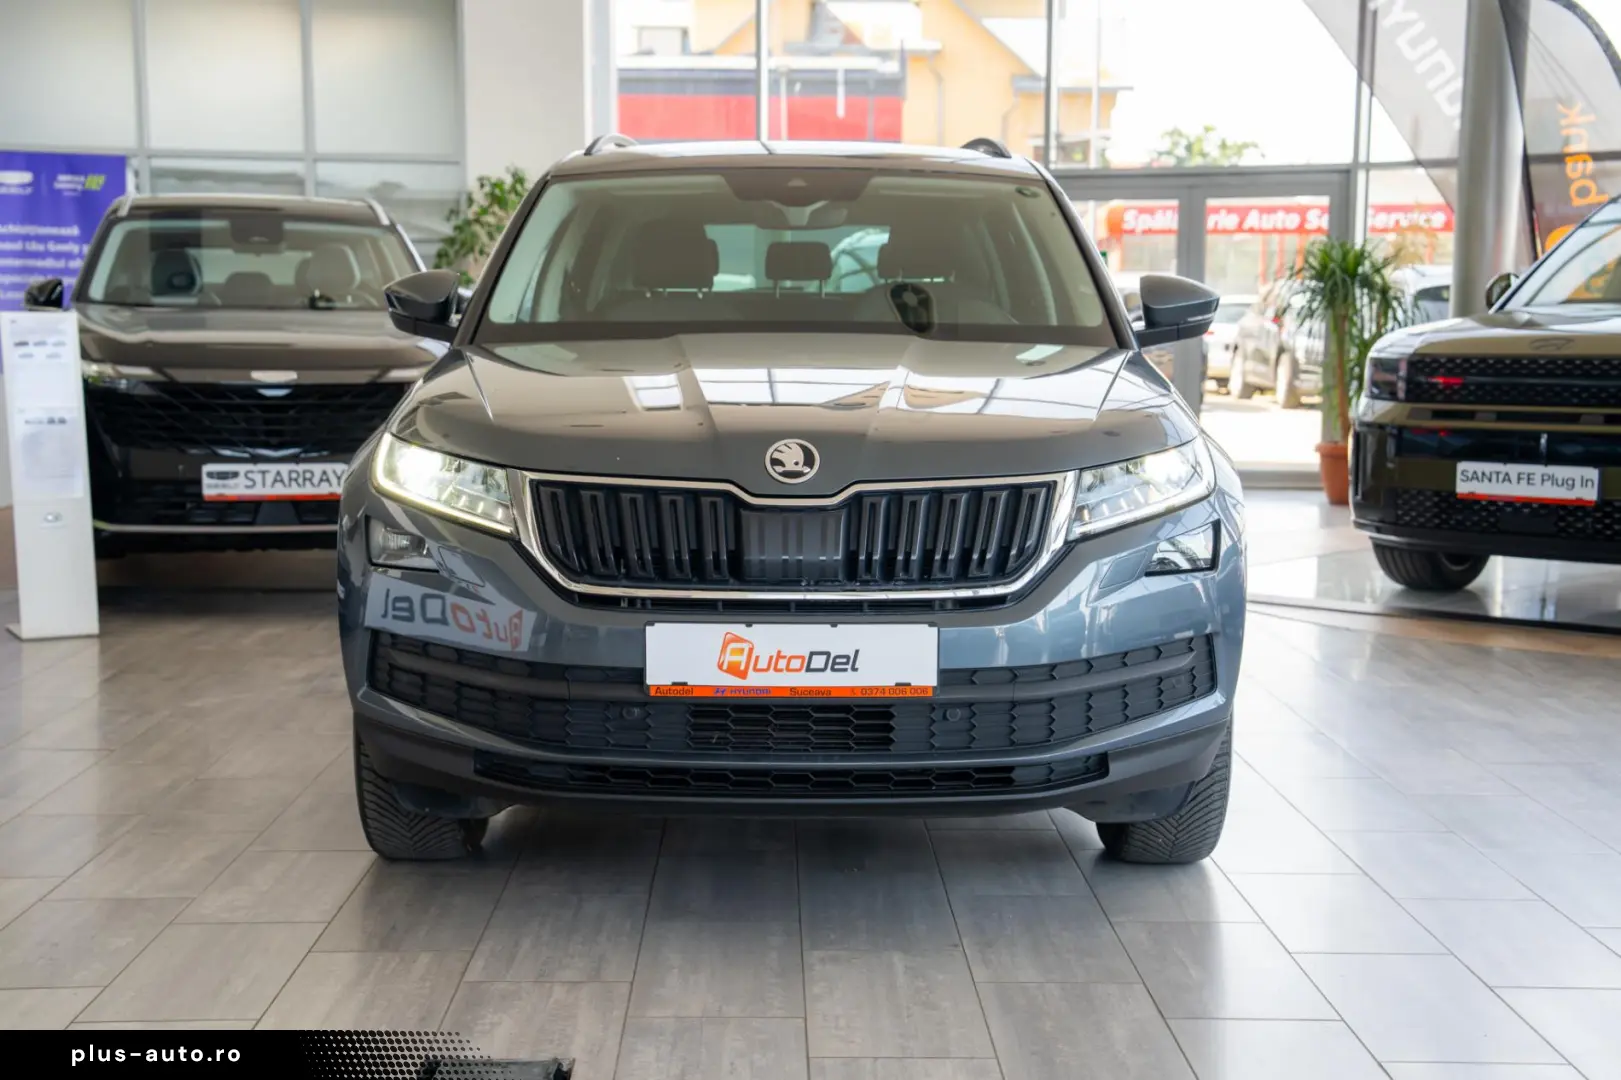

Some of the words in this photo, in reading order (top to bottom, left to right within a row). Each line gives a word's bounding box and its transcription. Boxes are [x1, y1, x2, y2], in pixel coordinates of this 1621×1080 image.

[1241, 208, 1301, 231] Auto
[244, 469, 344, 489] STARRAY
[1460, 469, 1512, 485] SANTA
[1517, 472, 1536, 486] FE
[1541, 473, 1576, 491] Plug
[1581, 475, 1595, 489] In
[718, 633, 860, 679] AutoDel
[654, 686, 694, 696] Autodel
[789, 687, 832, 697] Suceava
[860, 687, 886, 696] 0374
